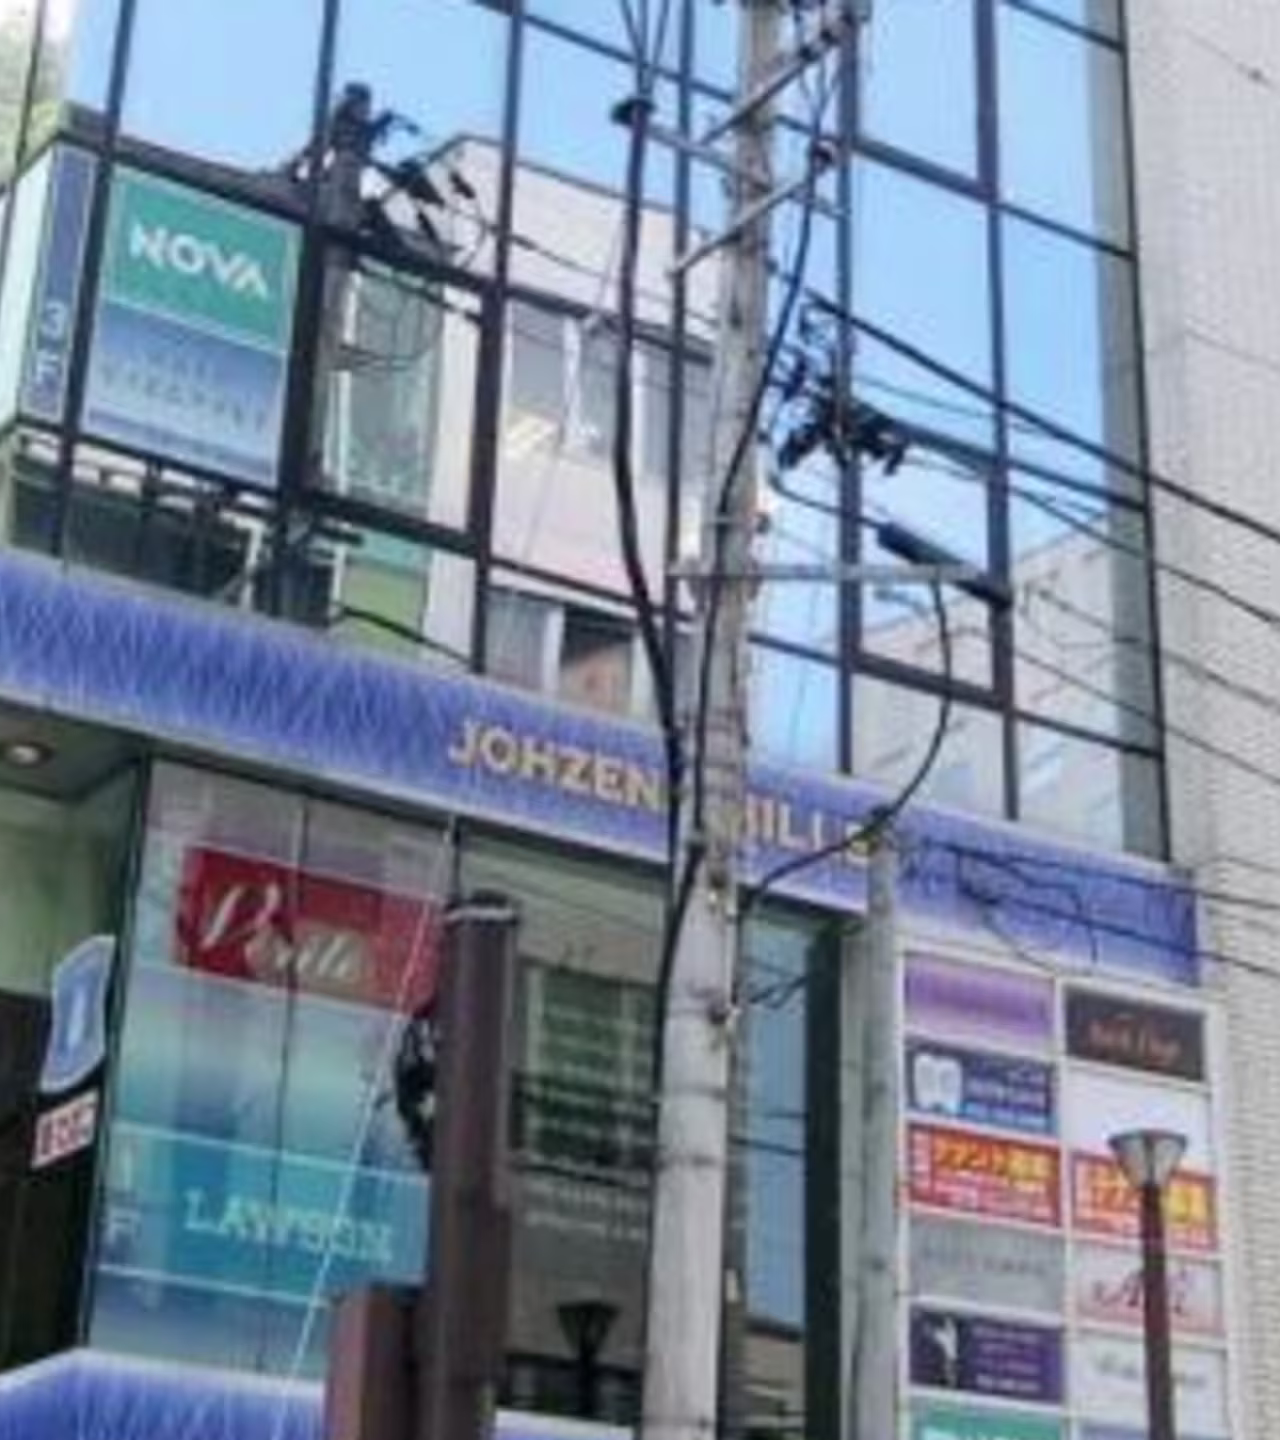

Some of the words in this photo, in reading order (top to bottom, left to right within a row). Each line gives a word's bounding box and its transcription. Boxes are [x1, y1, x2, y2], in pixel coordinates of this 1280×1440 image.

[128, 222, 268, 298] NOVA
[448, 717, 670, 813] JOHZEN
[185, 1189, 395, 1263] LAWSON
